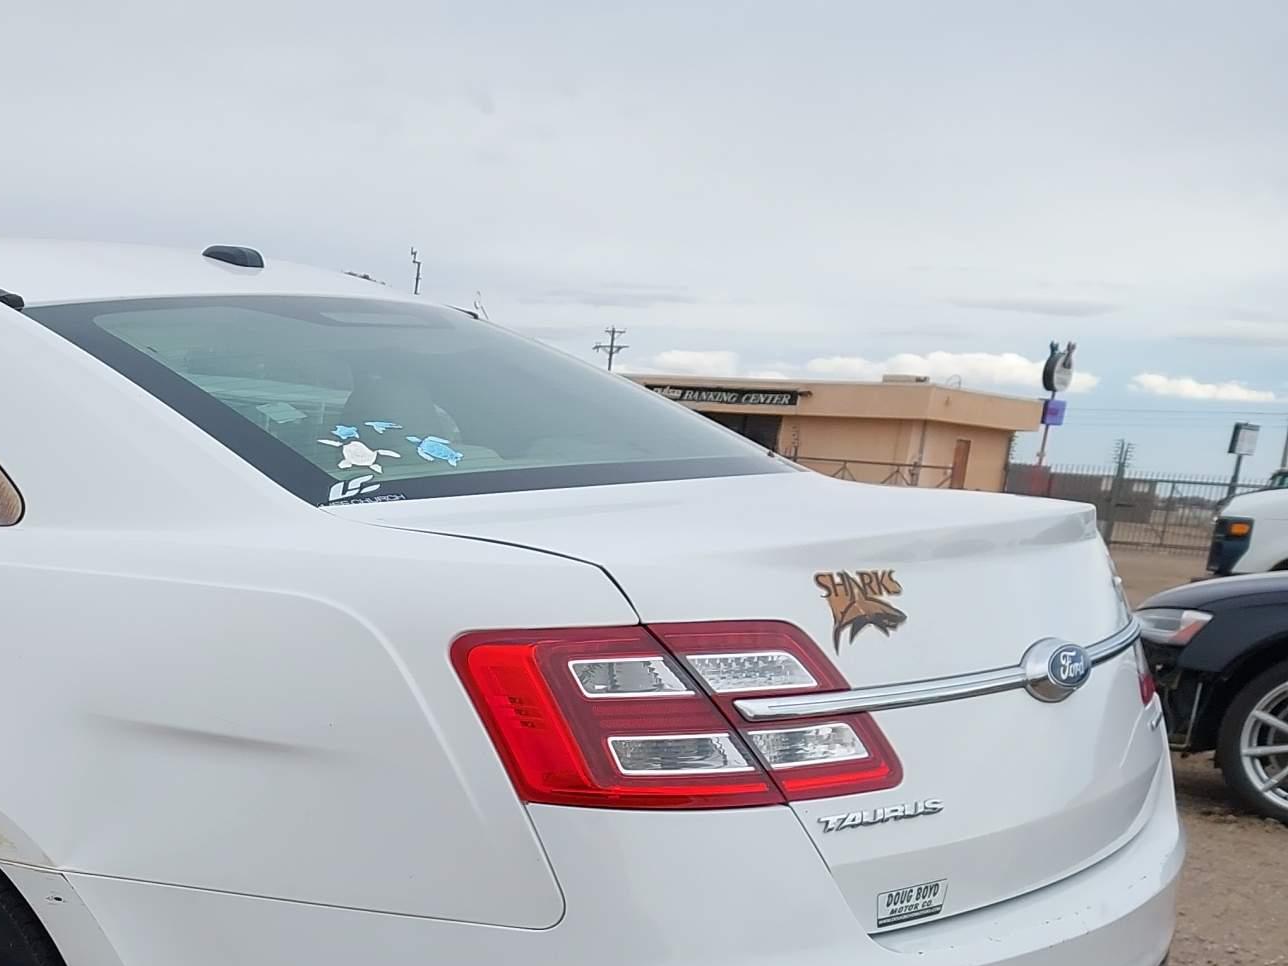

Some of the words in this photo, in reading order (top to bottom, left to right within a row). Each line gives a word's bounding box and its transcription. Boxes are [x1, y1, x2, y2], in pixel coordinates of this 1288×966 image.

[683, 390, 738, 403] BANKING
[741, 393, 792, 405] CENTER
[814, 569, 903, 599] SHARKS
[1060, 651, 1085, 680] Ford
[817, 799, 944, 833] TAURUS
[886, 889, 914, 907] DOUG
[915, 883, 940, 901] BOYD
[889, 902, 920, 915] MOTOR
